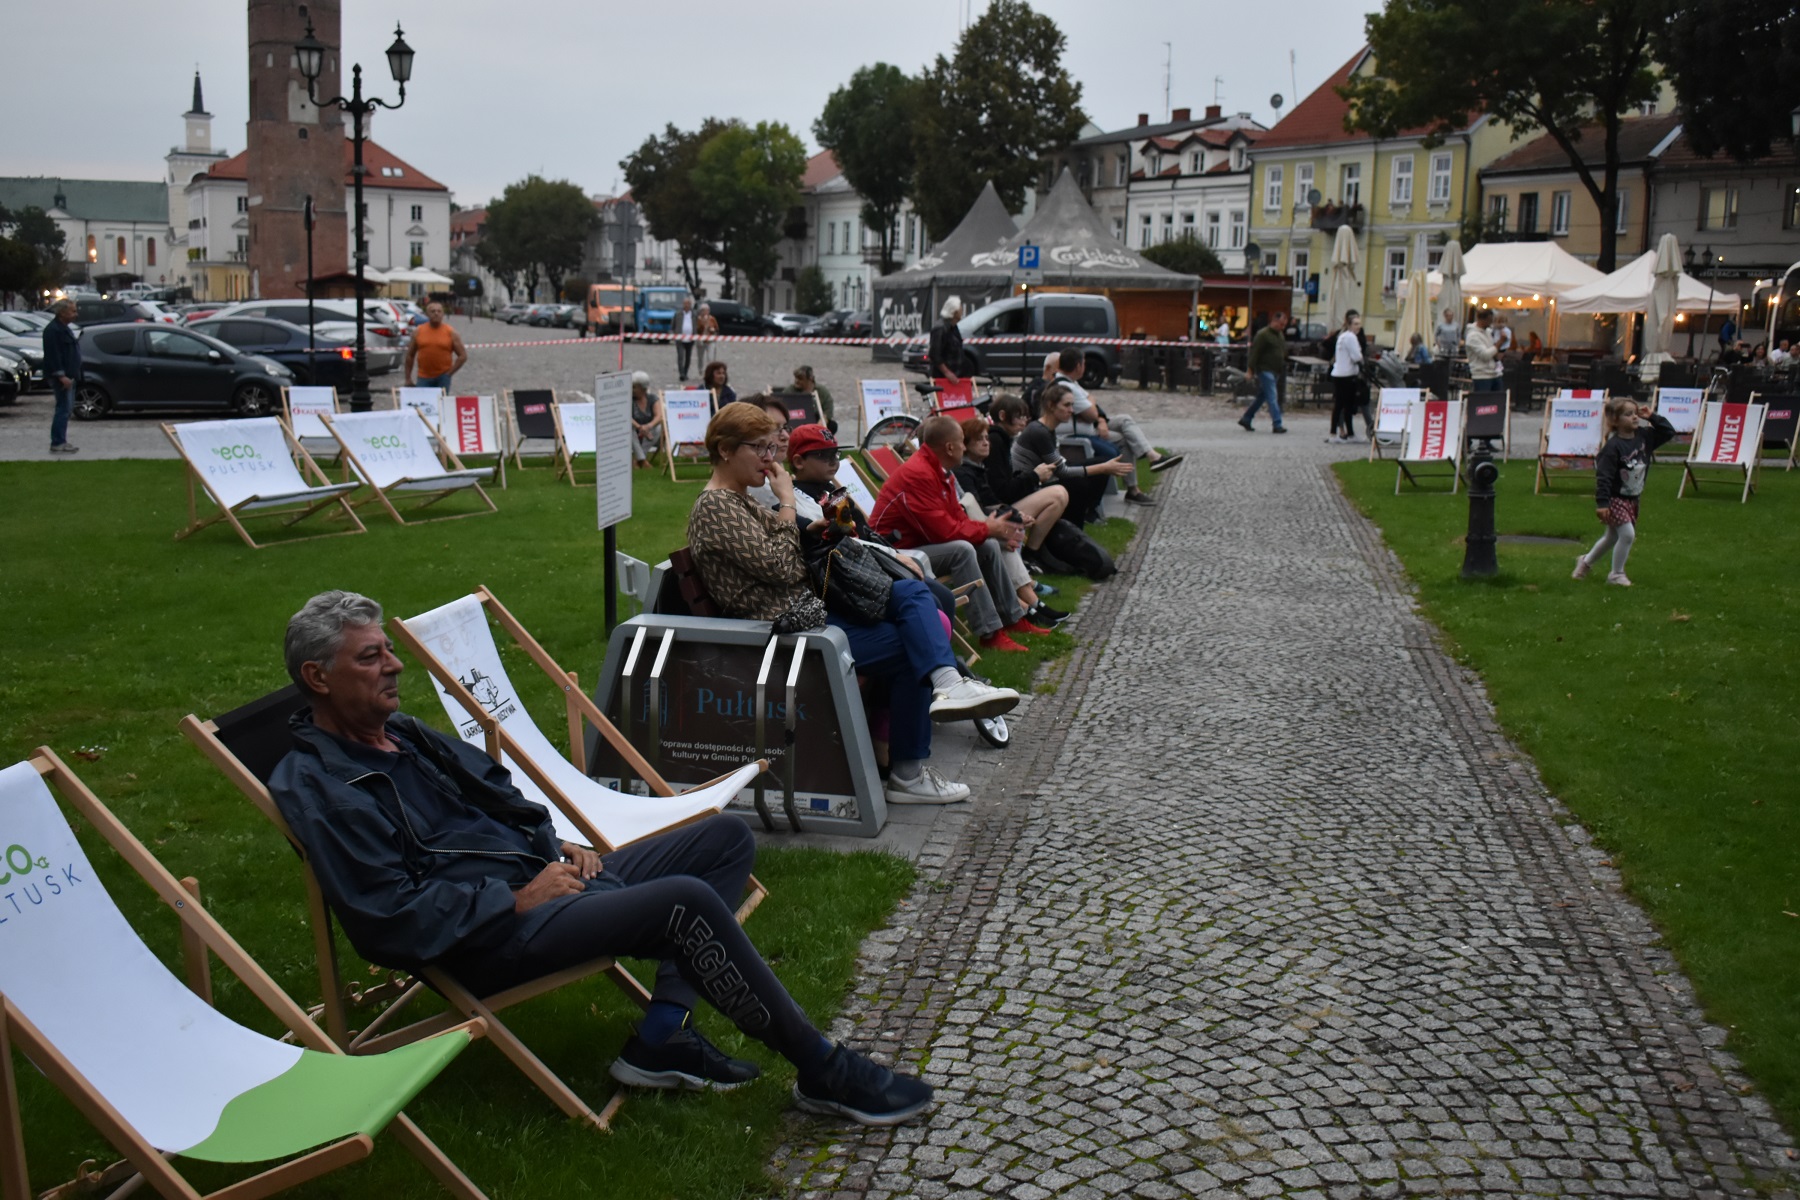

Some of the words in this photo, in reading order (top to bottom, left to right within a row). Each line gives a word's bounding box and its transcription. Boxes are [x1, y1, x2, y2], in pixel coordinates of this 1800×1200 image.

[1022, 248, 1035, 266] P
[1050, 246, 1139, 268] Carlsberg
[879, 297, 921, 338] Carlsberg
[370, 435, 400, 449] eco
[220, 445, 254, 460] eco
[209, 461, 276, 475] PUŁTUSK
[694, 742, 744, 753] dostępności
[745, 745, 756, 753] do
[672, 751, 700, 760] kultury
[711, 753, 739, 763] Gminie
[665, 904, 771, 1030] LEGEND
